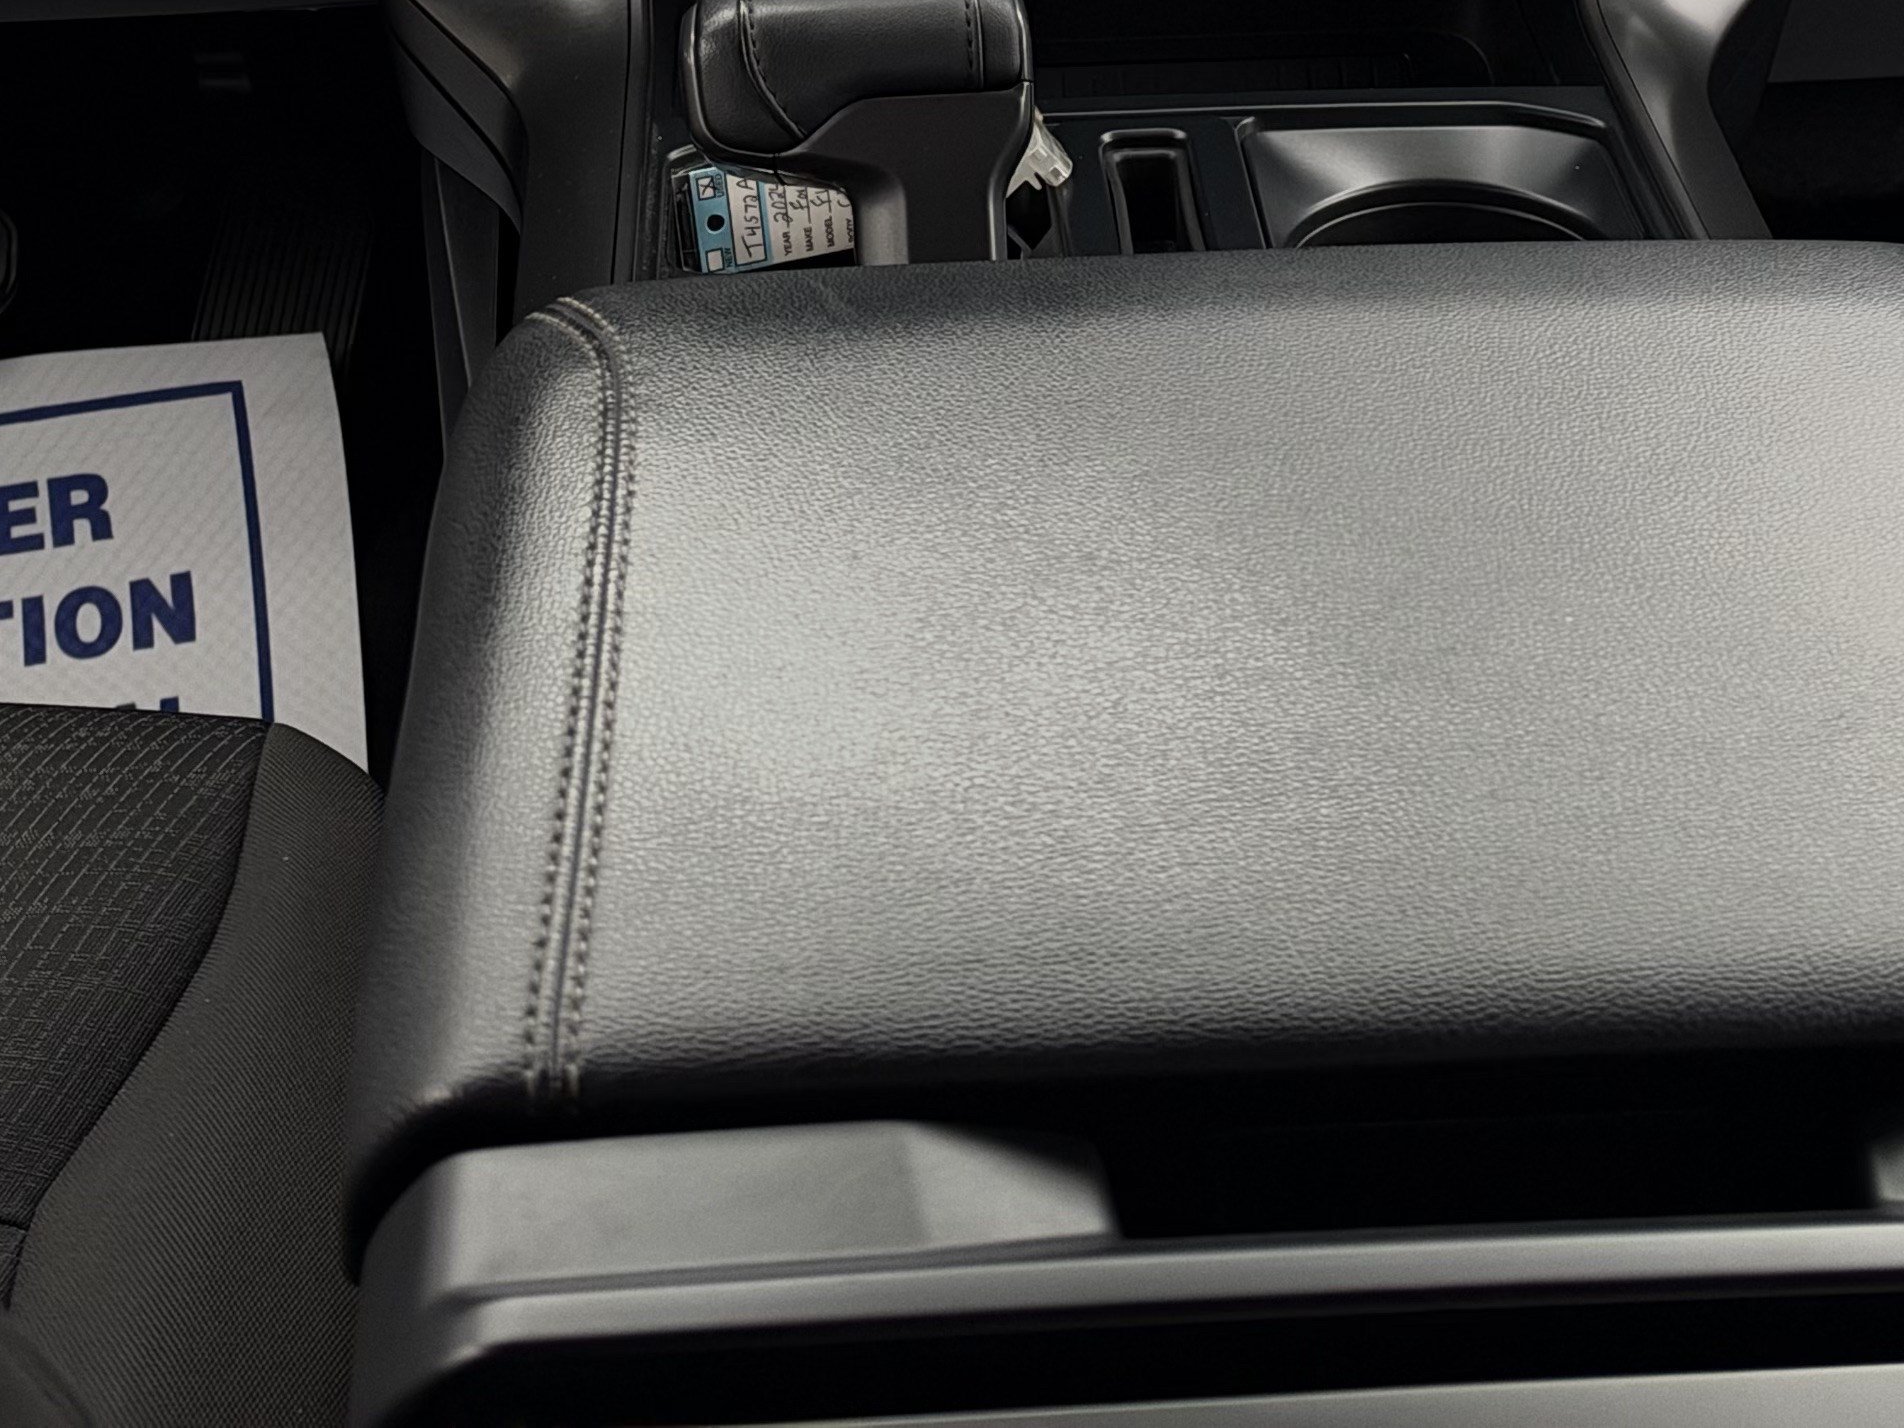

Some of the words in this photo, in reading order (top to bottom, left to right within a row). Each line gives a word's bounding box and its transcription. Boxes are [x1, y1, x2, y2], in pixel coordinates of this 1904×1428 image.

[782, 231, 792, 256] YEAR
[803, 226, 814, 252] MAKE
[823, 214, 835, 248] MODEL
